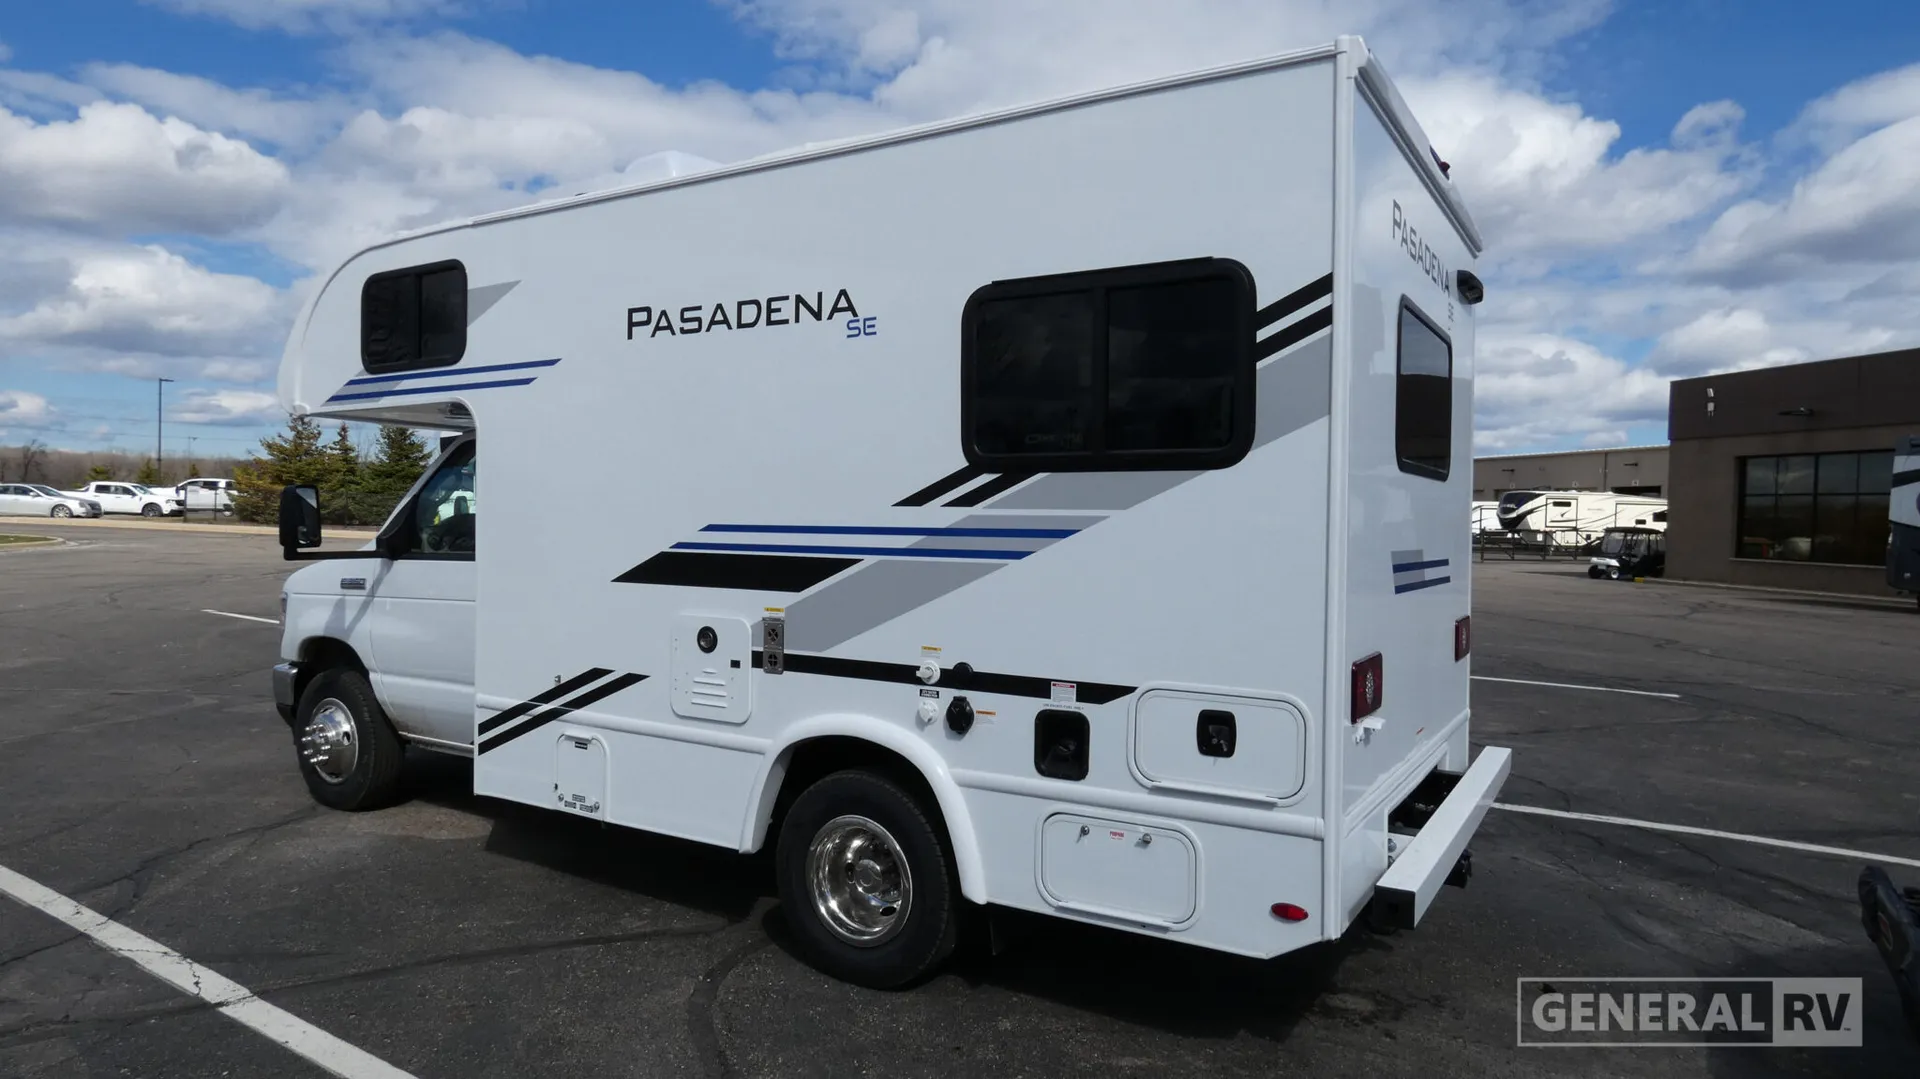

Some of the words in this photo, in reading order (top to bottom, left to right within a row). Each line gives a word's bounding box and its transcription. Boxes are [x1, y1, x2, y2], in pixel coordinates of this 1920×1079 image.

[1392, 199, 1450, 299] PASADENA
[626, 288, 859, 341] PASADENA
[846, 316, 877, 338] SE
